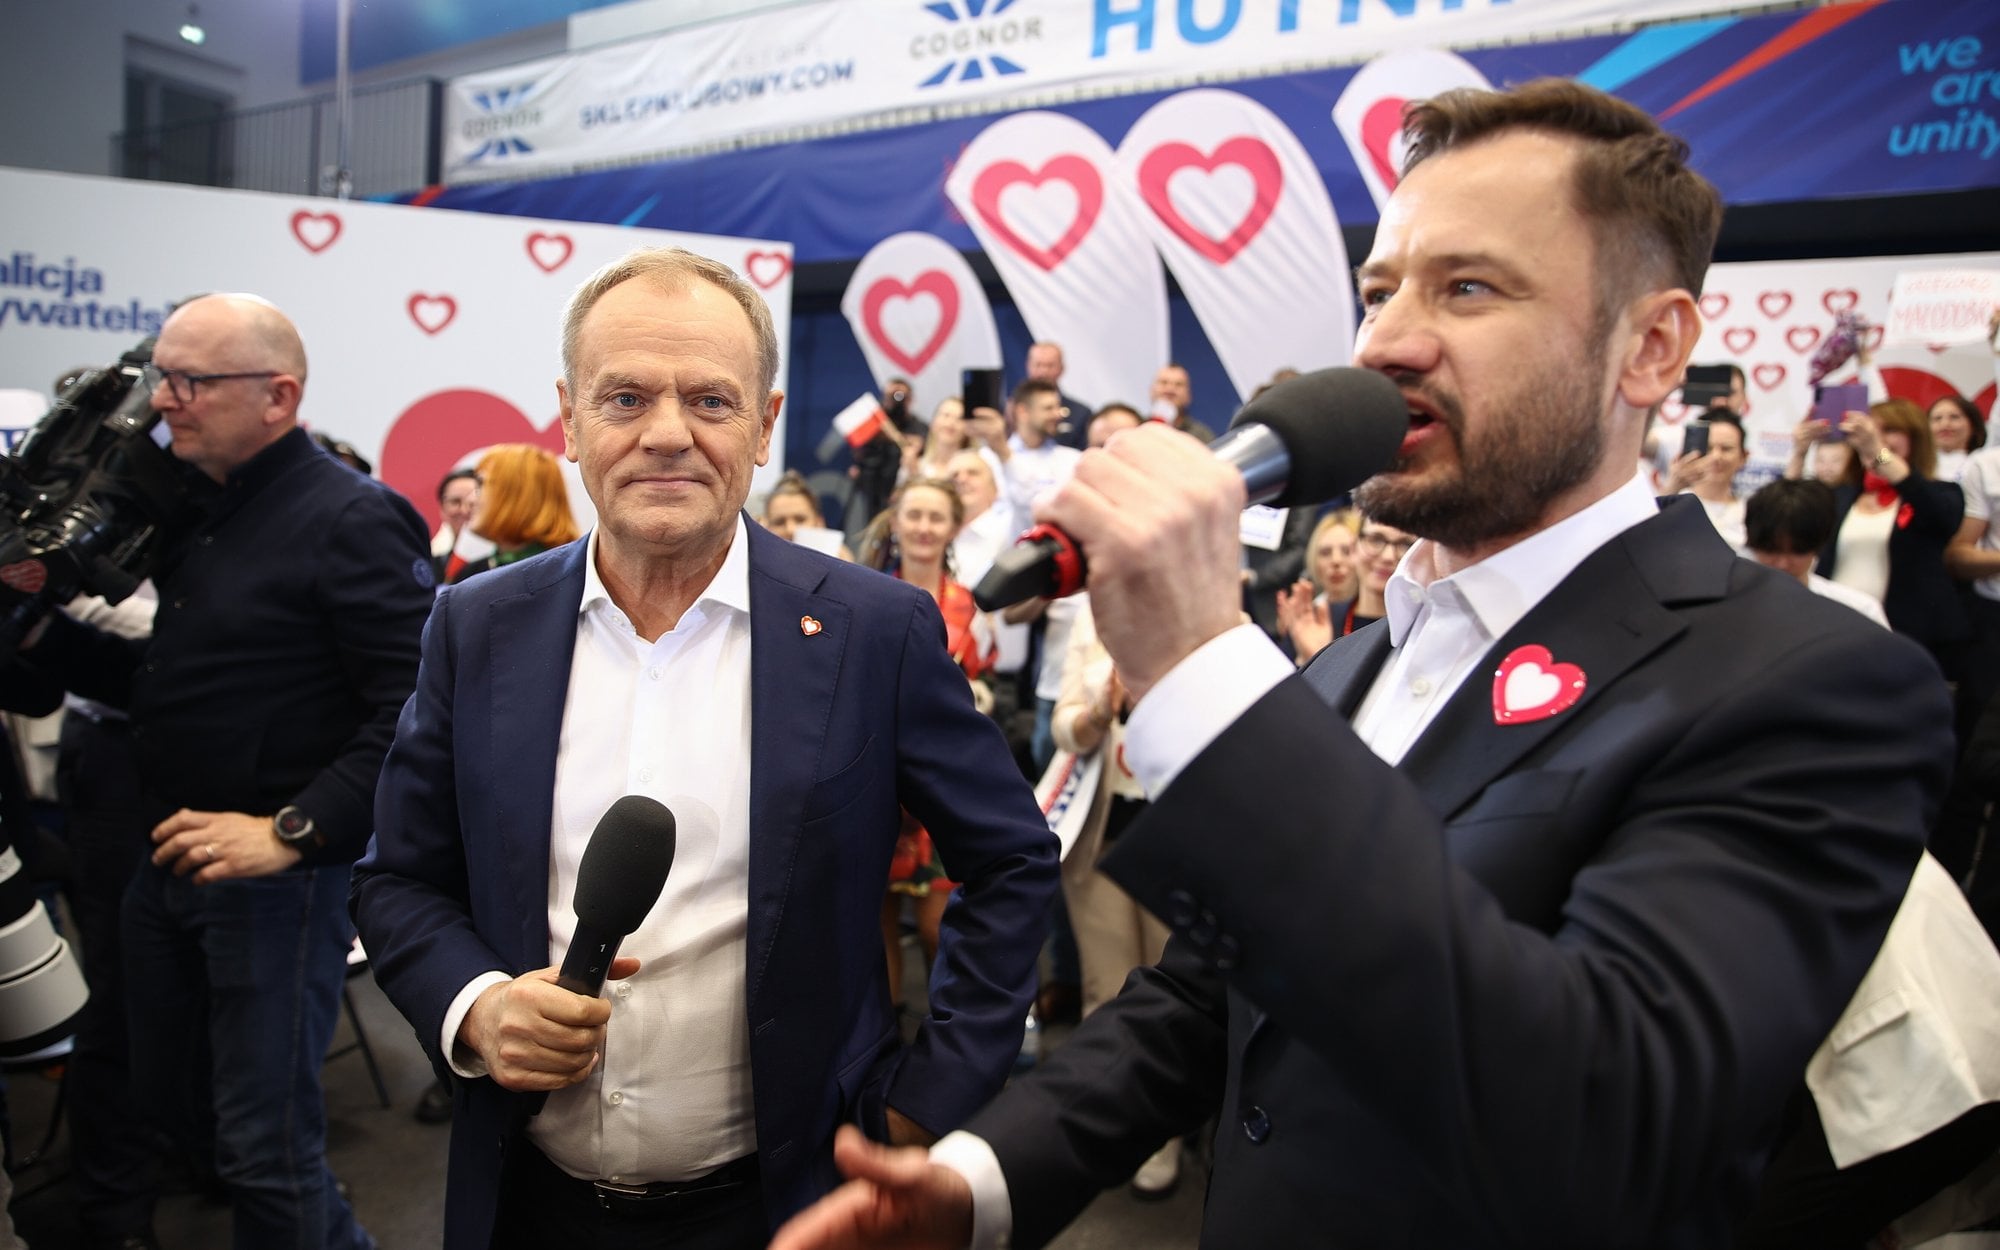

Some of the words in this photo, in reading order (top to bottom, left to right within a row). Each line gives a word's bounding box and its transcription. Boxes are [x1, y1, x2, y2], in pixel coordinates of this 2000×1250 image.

[909, 16, 1043, 60] COGNOR
[1899, 35, 1982, 75] we
[0, 297, 176, 335] watels
